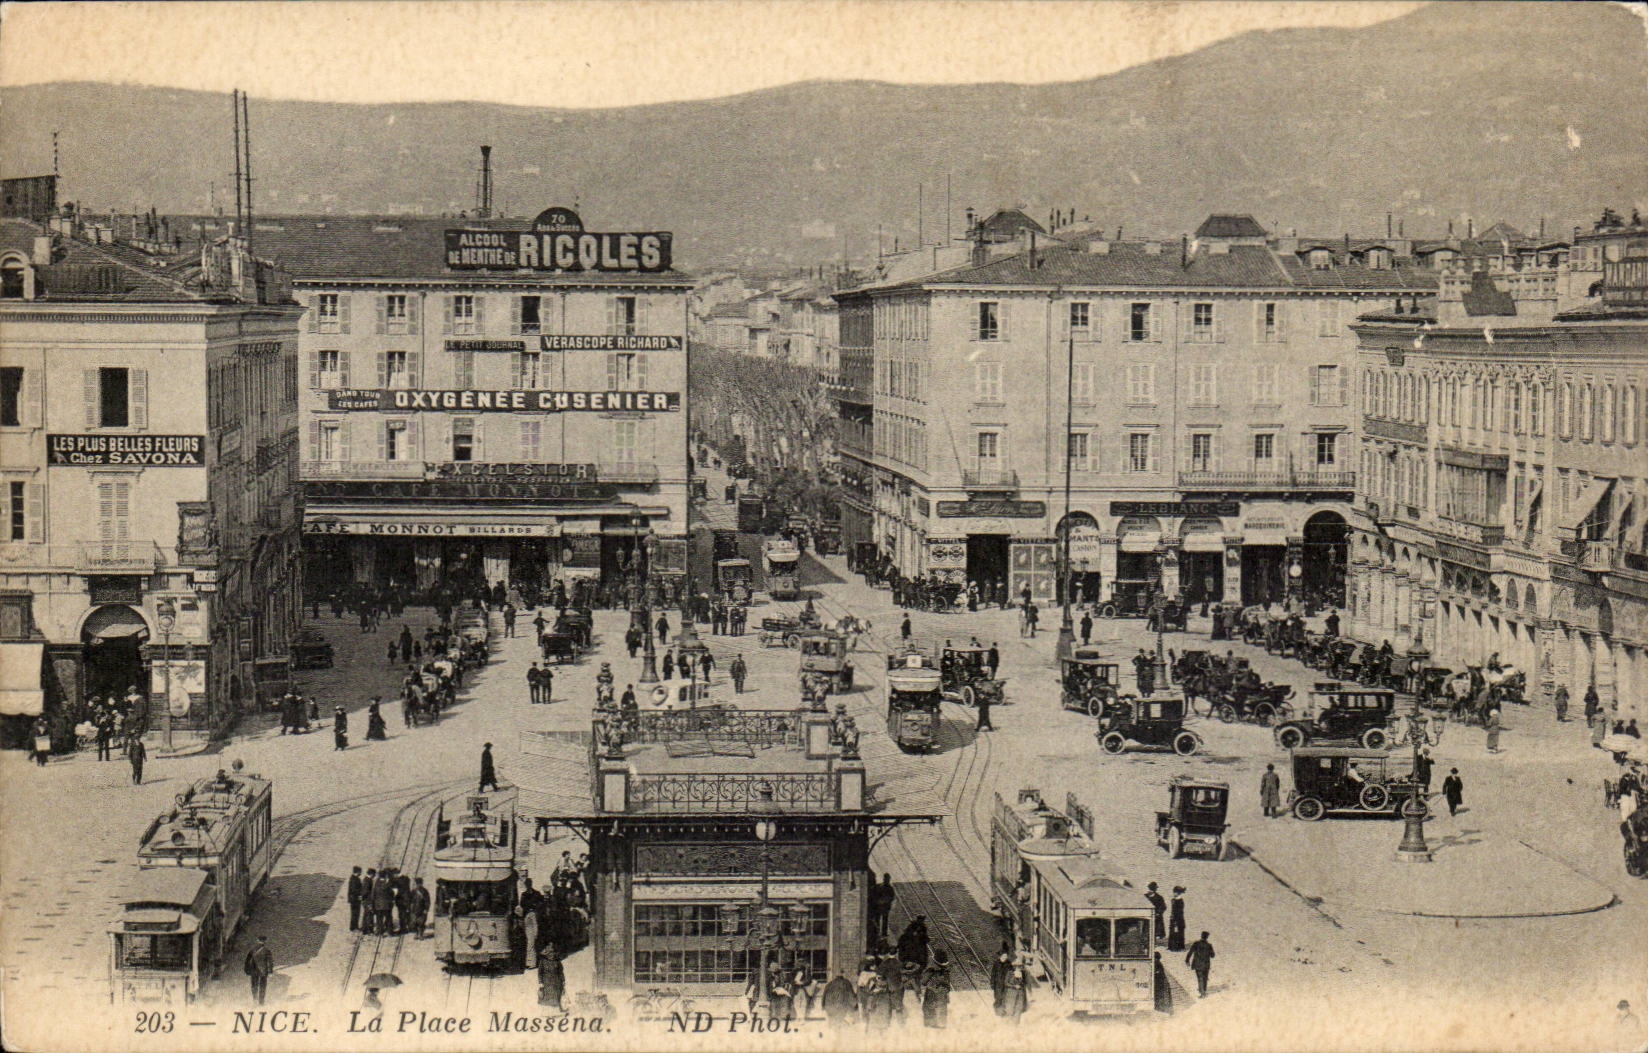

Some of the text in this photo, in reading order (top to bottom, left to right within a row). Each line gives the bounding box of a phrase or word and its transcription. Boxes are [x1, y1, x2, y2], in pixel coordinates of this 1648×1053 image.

[551, 214, 566, 224] 70
[460, 233, 507, 247] ALCOOL
[448, 251, 460, 264] DE
[461, 247, 503, 264] MENTHE
[459, 340, 482, 349] PETIT
[486, 340, 523, 349] JOURNAL
[617, 336, 667, 349] RICHARD
[336, 390, 380, 399] DANS TOUS
[538, 392, 668, 410] CUSENIER
[338, 400, 352, 408] LES
[53, 436, 199, 452] LES PLUS BELLES FLEURS
[70, 451, 198, 464] Chez SAVONA
[434, 463, 587, 479] EXCELSIOR
[1139, 503, 1210, 514] LEBLANC
[369, 524, 457, 535] MONNOT
[468, 526, 532, 535] BILLARDS
